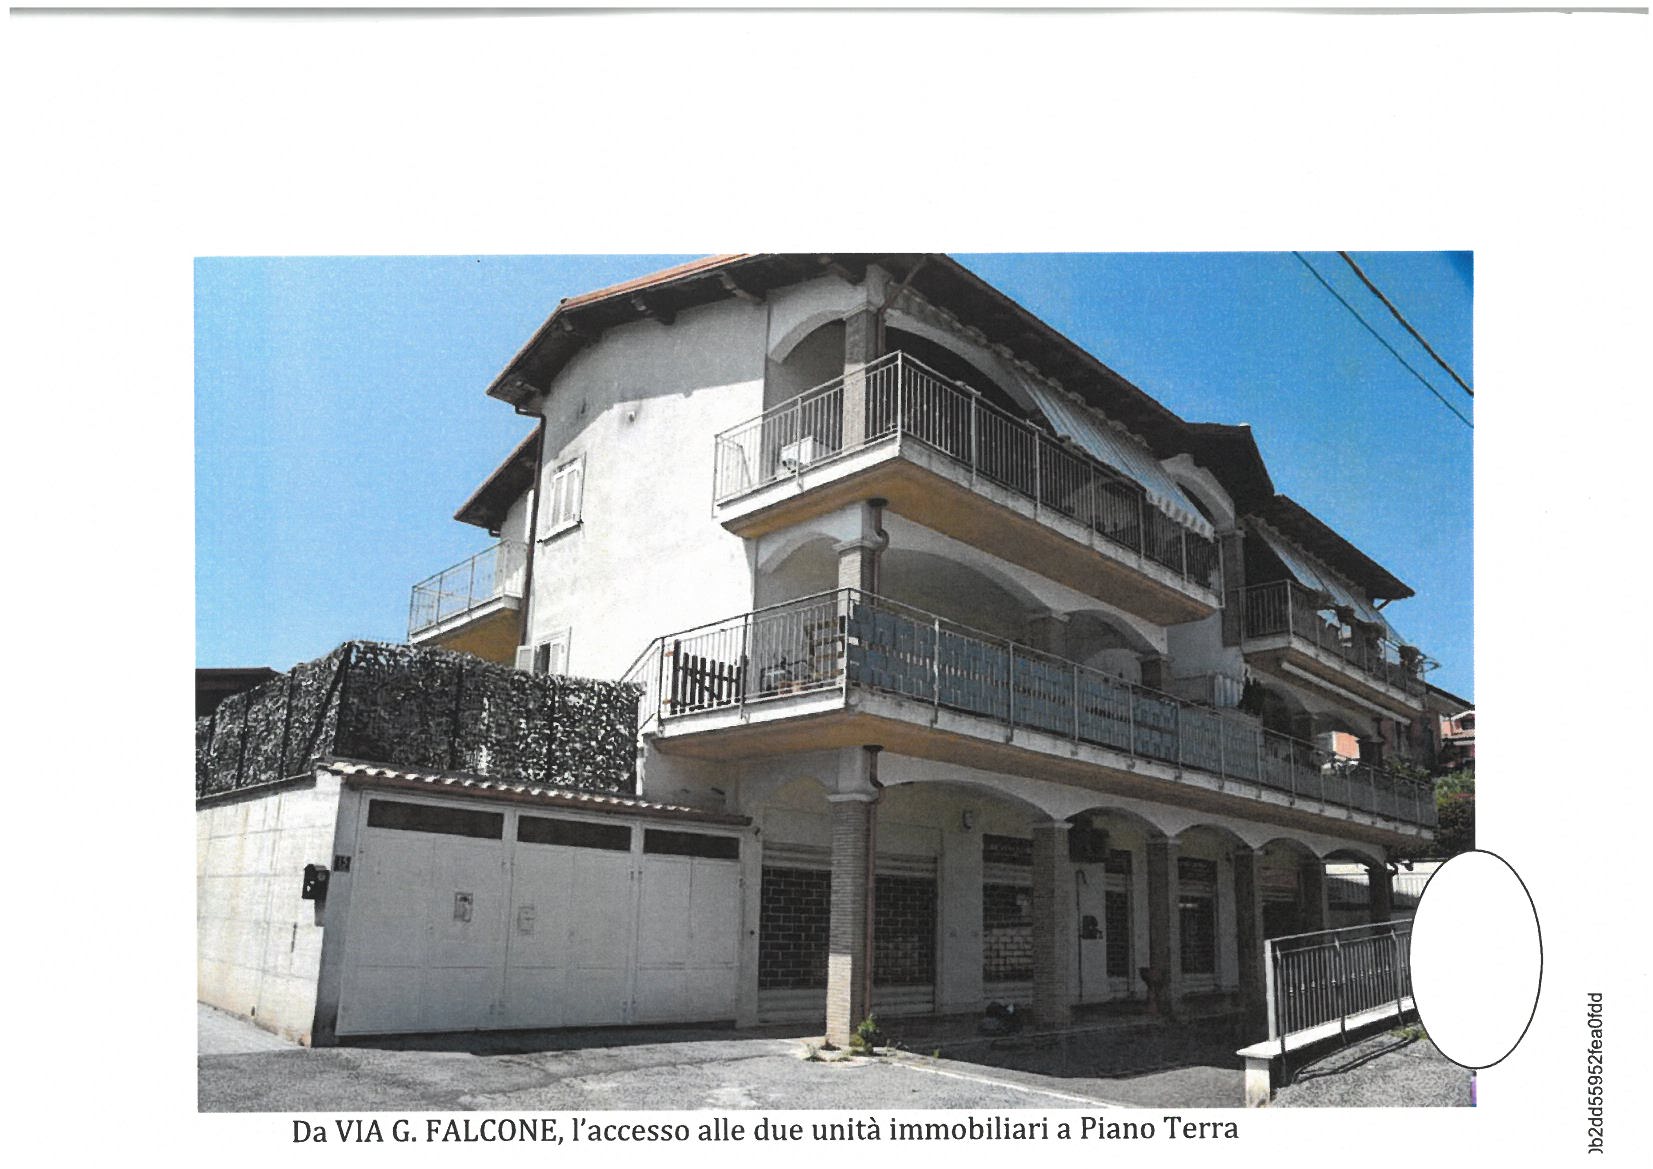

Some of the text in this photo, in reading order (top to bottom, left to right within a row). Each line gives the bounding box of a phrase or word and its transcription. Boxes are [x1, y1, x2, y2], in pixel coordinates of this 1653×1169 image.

[292, 1121, 328, 1143] Da
[335, 1120, 384, 1143] VIA
[393, 1120, 417, 1143] G.
[426, 1119, 564, 1146] FALCONE,
[699, 1118, 745, 1142] alle
[754, 1118, 804, 1141] due
[813, 1117, 881, 1141] unità
[890, 1117, 1049, 1141] immobiliari
[1058, 1123, 1072, 1140] a
[1081, 1117, 1156, 1140] Piano
[1164, 1117, 1240, 1139] Terra
